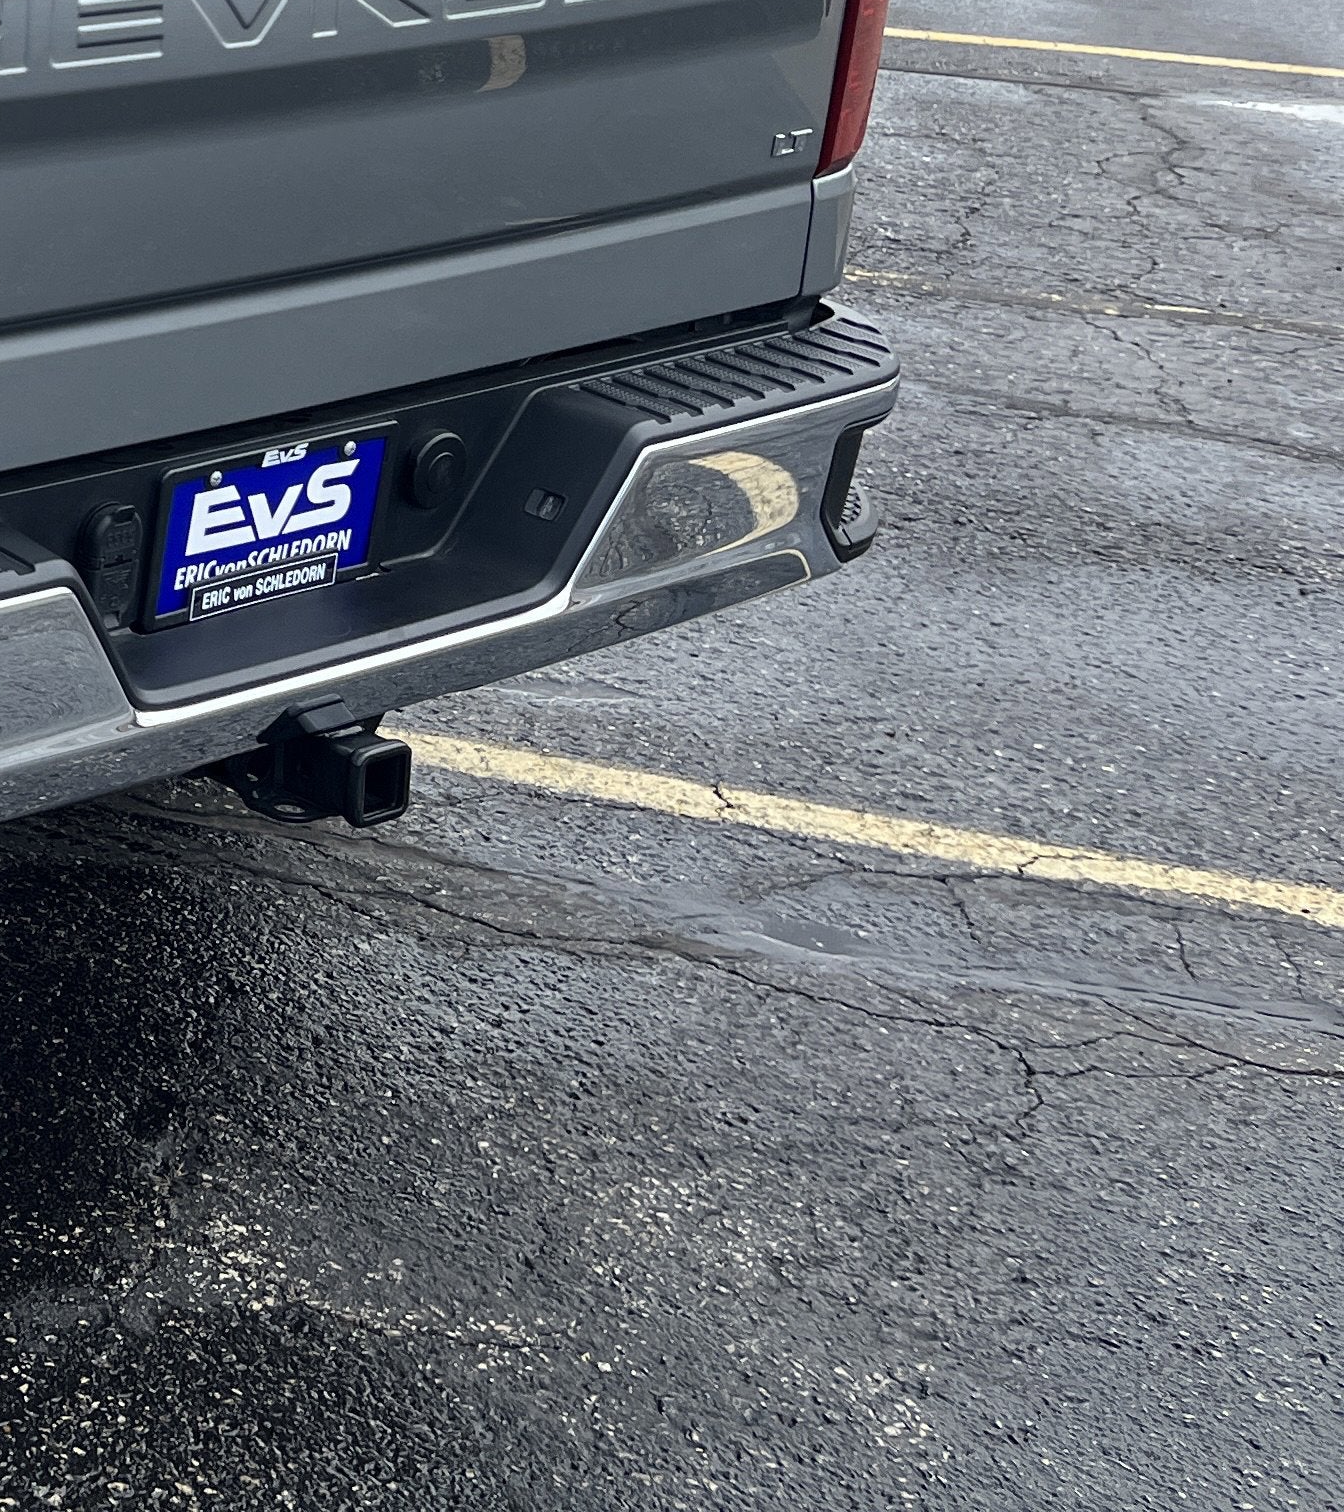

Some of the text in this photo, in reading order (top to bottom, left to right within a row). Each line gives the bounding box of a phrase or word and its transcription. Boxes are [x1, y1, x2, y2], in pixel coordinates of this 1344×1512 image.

[771, 128, 813, 158] LT
[201, 562, 327, 611] ERIC von SCHLEDORN
